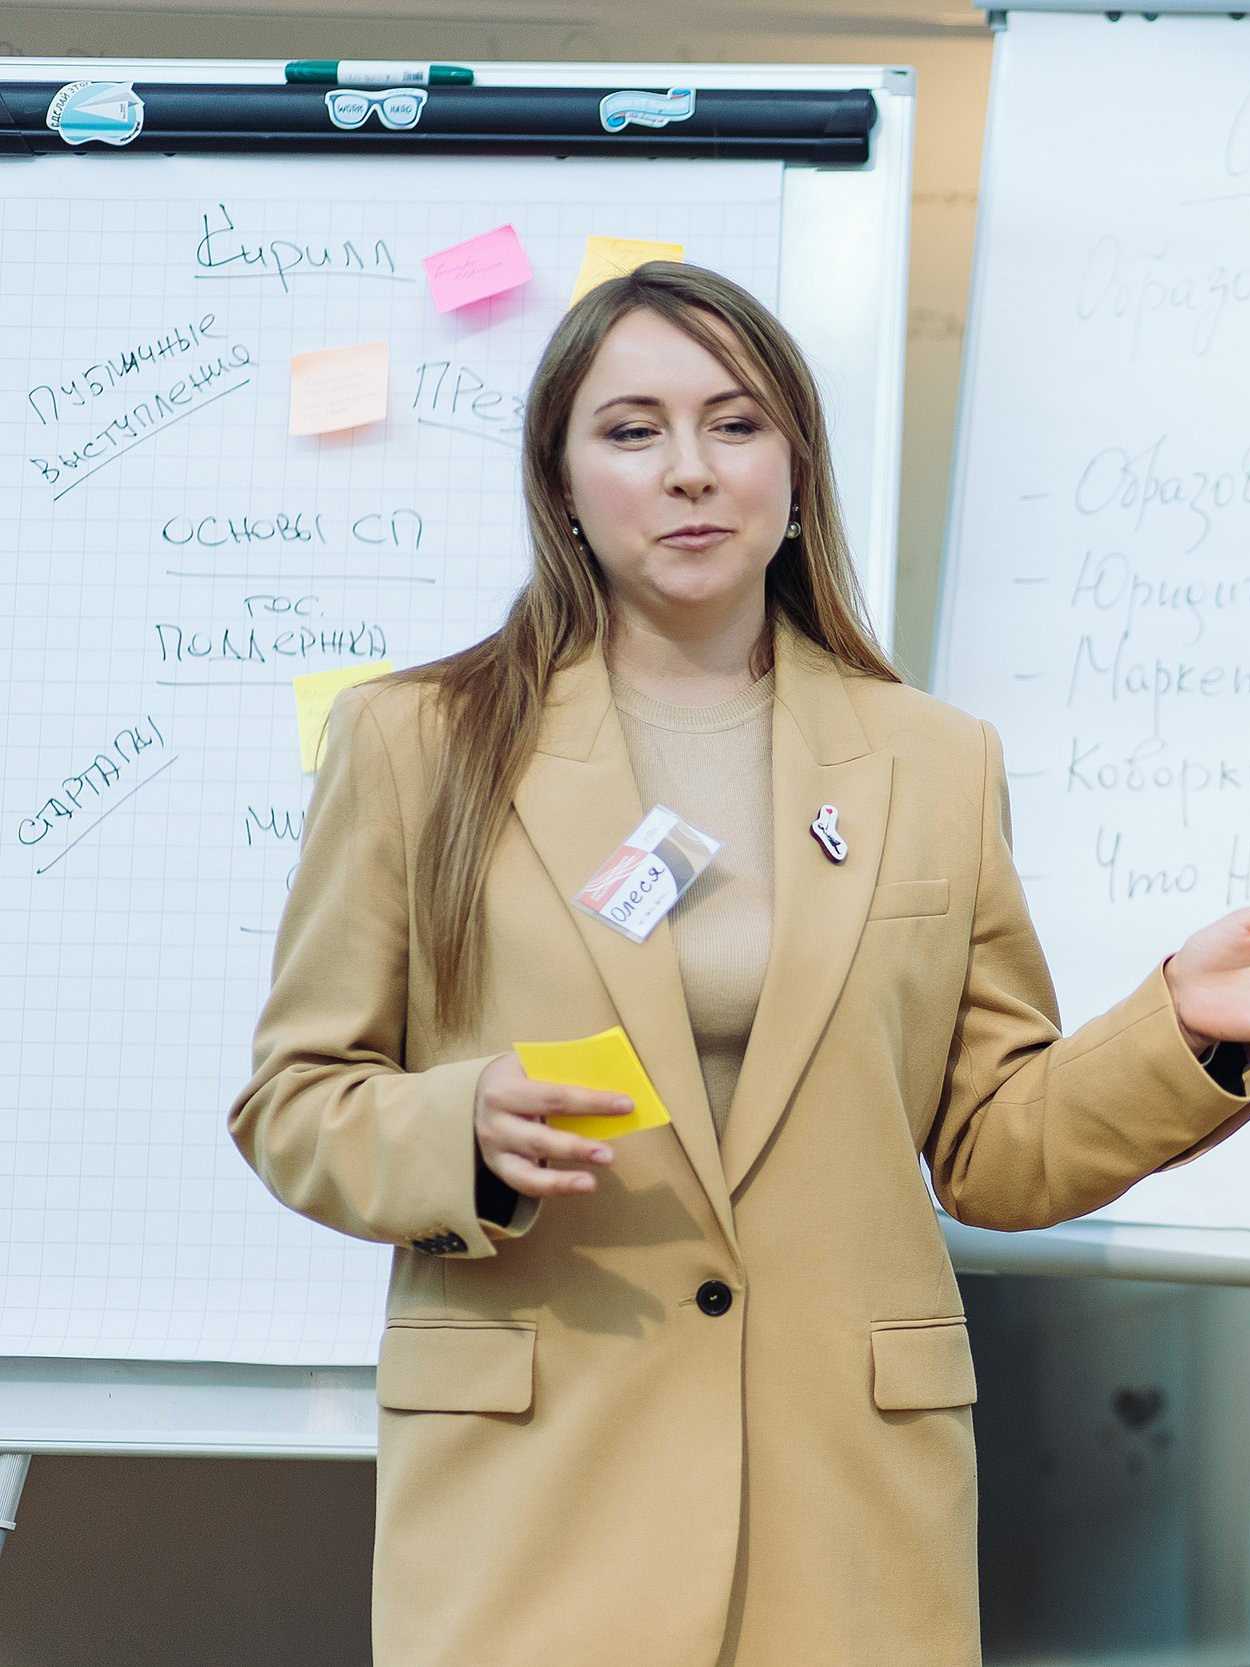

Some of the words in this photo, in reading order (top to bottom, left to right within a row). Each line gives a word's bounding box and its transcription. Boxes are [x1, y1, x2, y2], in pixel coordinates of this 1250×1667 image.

[197, 203, 395, 293] Кирилл
[610, 866, 666, 923] Олеся
[1095, 825, 1200, 903] Что
